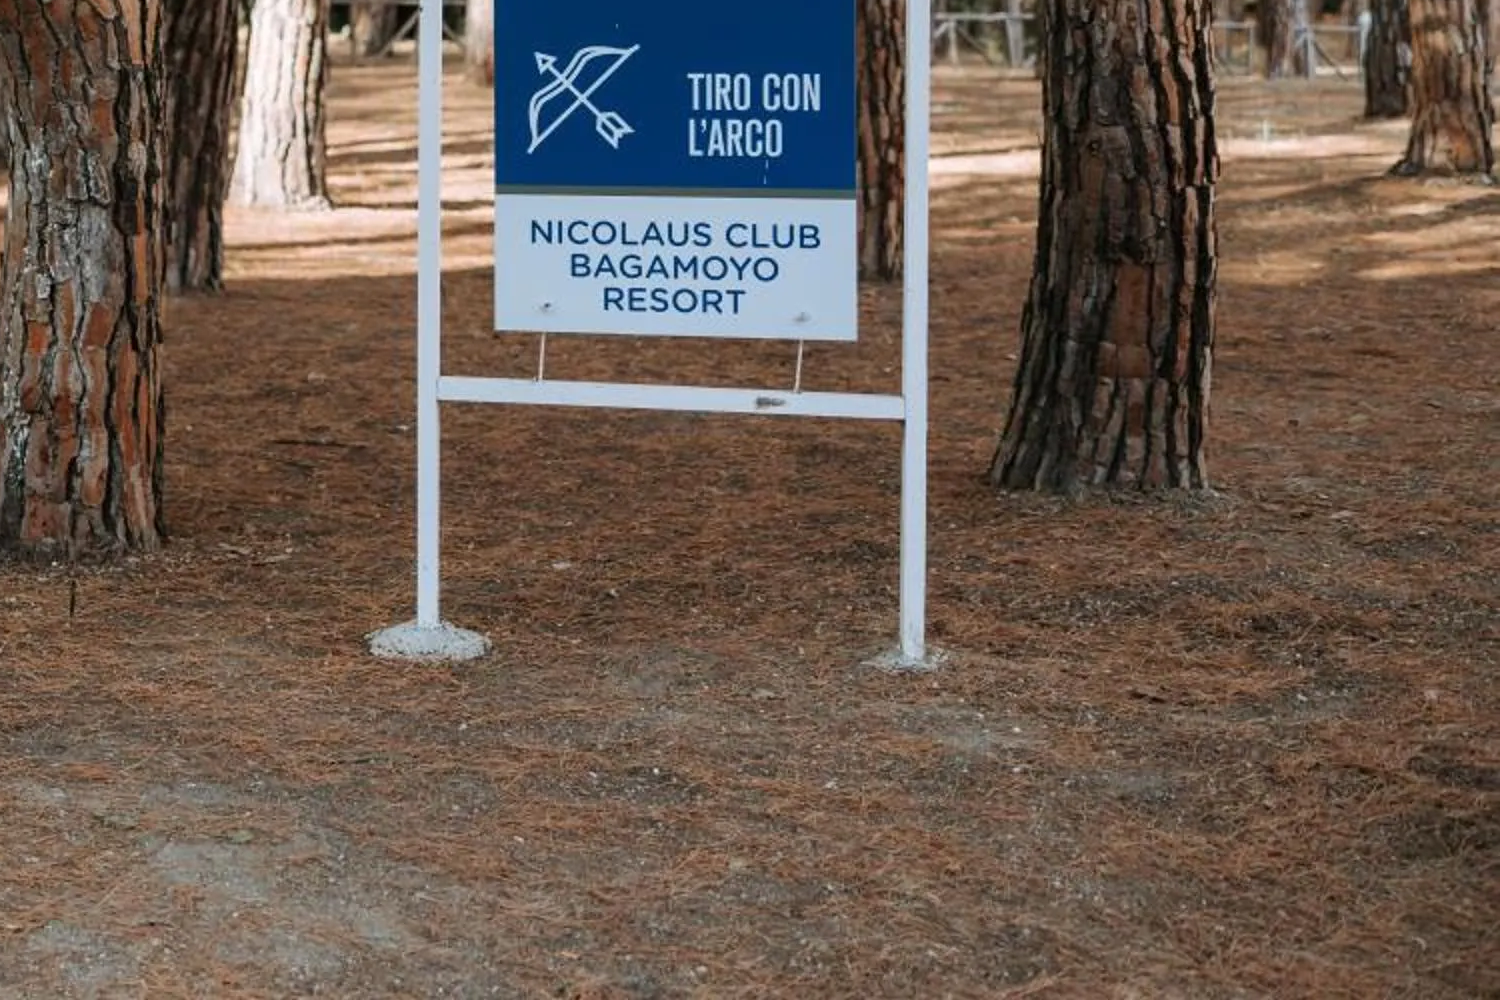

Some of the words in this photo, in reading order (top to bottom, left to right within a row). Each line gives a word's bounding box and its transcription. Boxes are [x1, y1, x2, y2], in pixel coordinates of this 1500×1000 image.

[687, 73, 751, 111] TIRO
[763, 73, 821, 111] CON
[688, 119, 783, 157] L'ARCO
[531, 220, 712, 247] NICOLAUS
[725, 223, 821, 249] CLUB
[570, 253, 779, 282] BAGAMOYO
[603, 287, 746, 314] RESORT
